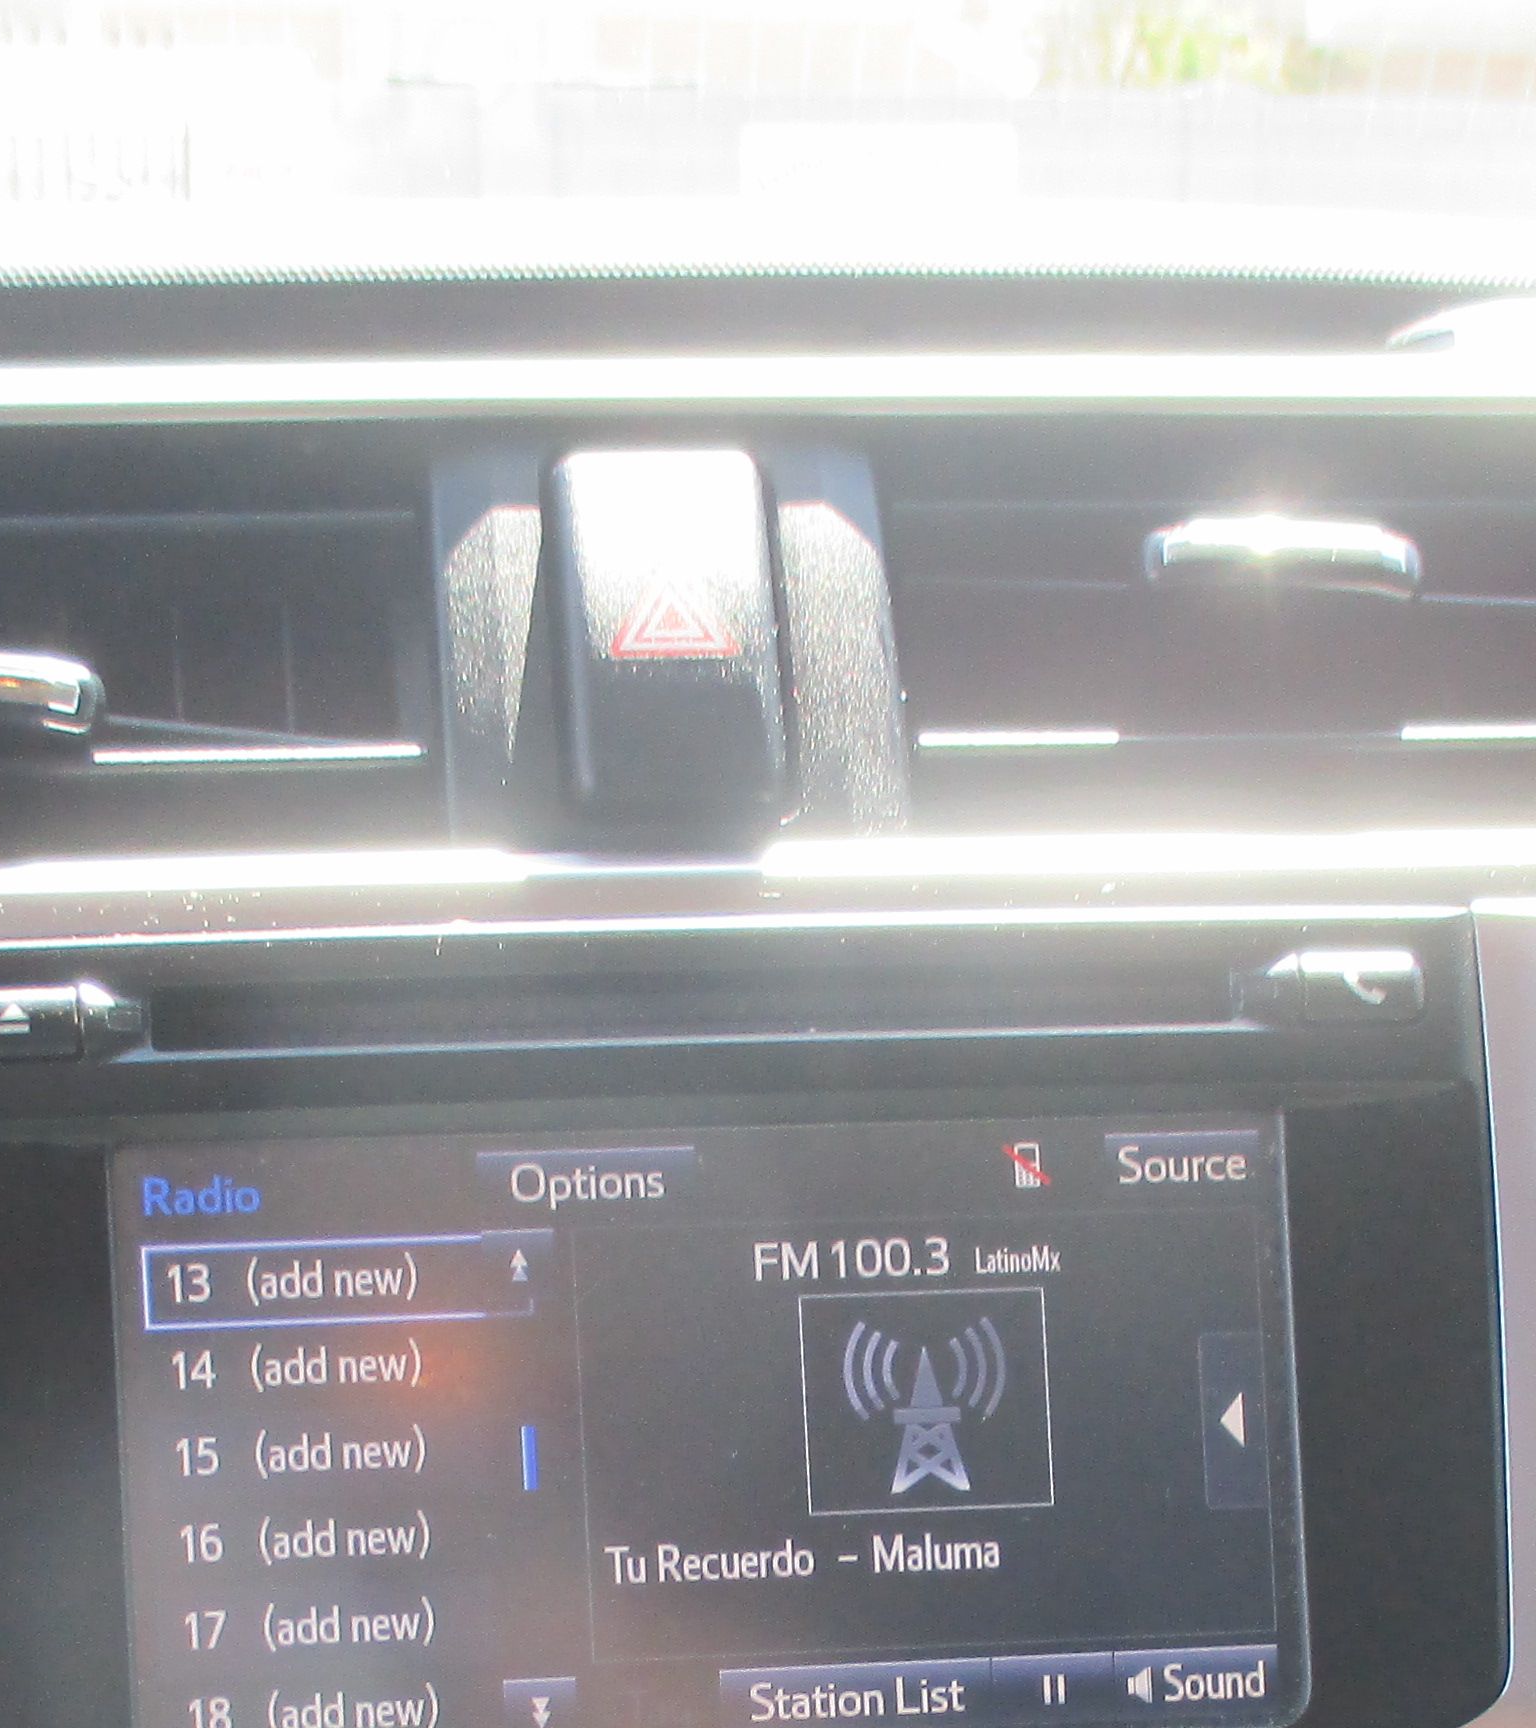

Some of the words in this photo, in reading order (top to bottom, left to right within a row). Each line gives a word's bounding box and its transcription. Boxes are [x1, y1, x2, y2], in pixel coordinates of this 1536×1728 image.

[510, 1162, 666, 1210] Options
[1117, 1146, 1247, 1183] Source
[141, 1175, 261, 1216] Radio
[167, 1264, 212, 1304] 13
[246, 1256, 326, 1306] (add
[333, 1252, 418, 1300] new)
[754, 1241, 819, 1281] FM
[831, 1238, 951, 1279] 100.3
[171, 1350, 216, 1389] 14
[250, 1341, 328, 1392] (add
[339, 1338, 422, 1386] new)
[175, 1437, 219, 1476] 15
[254, 1429, 332, 1479] (add
[342, 1424, 426, 1473] new)
[180, 1523, 224, 1563] 16
[259, 1516, 336, 1566] (add
[346, 1510, 431, 1559] new)
[605, 1546, 648, 1585] Tu
[658, 1540, 815, 1584] Recuerdo
[872, 1536, 1001, 1574] Maluma
[184, 1609, 227, 1650] 17
[264, 1602, 341, 1652] (add
[351, 1596, 436, 1646] new)
[751, 1684, 884, 1722] Station
[895, 1680, 966, 1718] List
[1163, 1660, 1267, 1703] Sound
